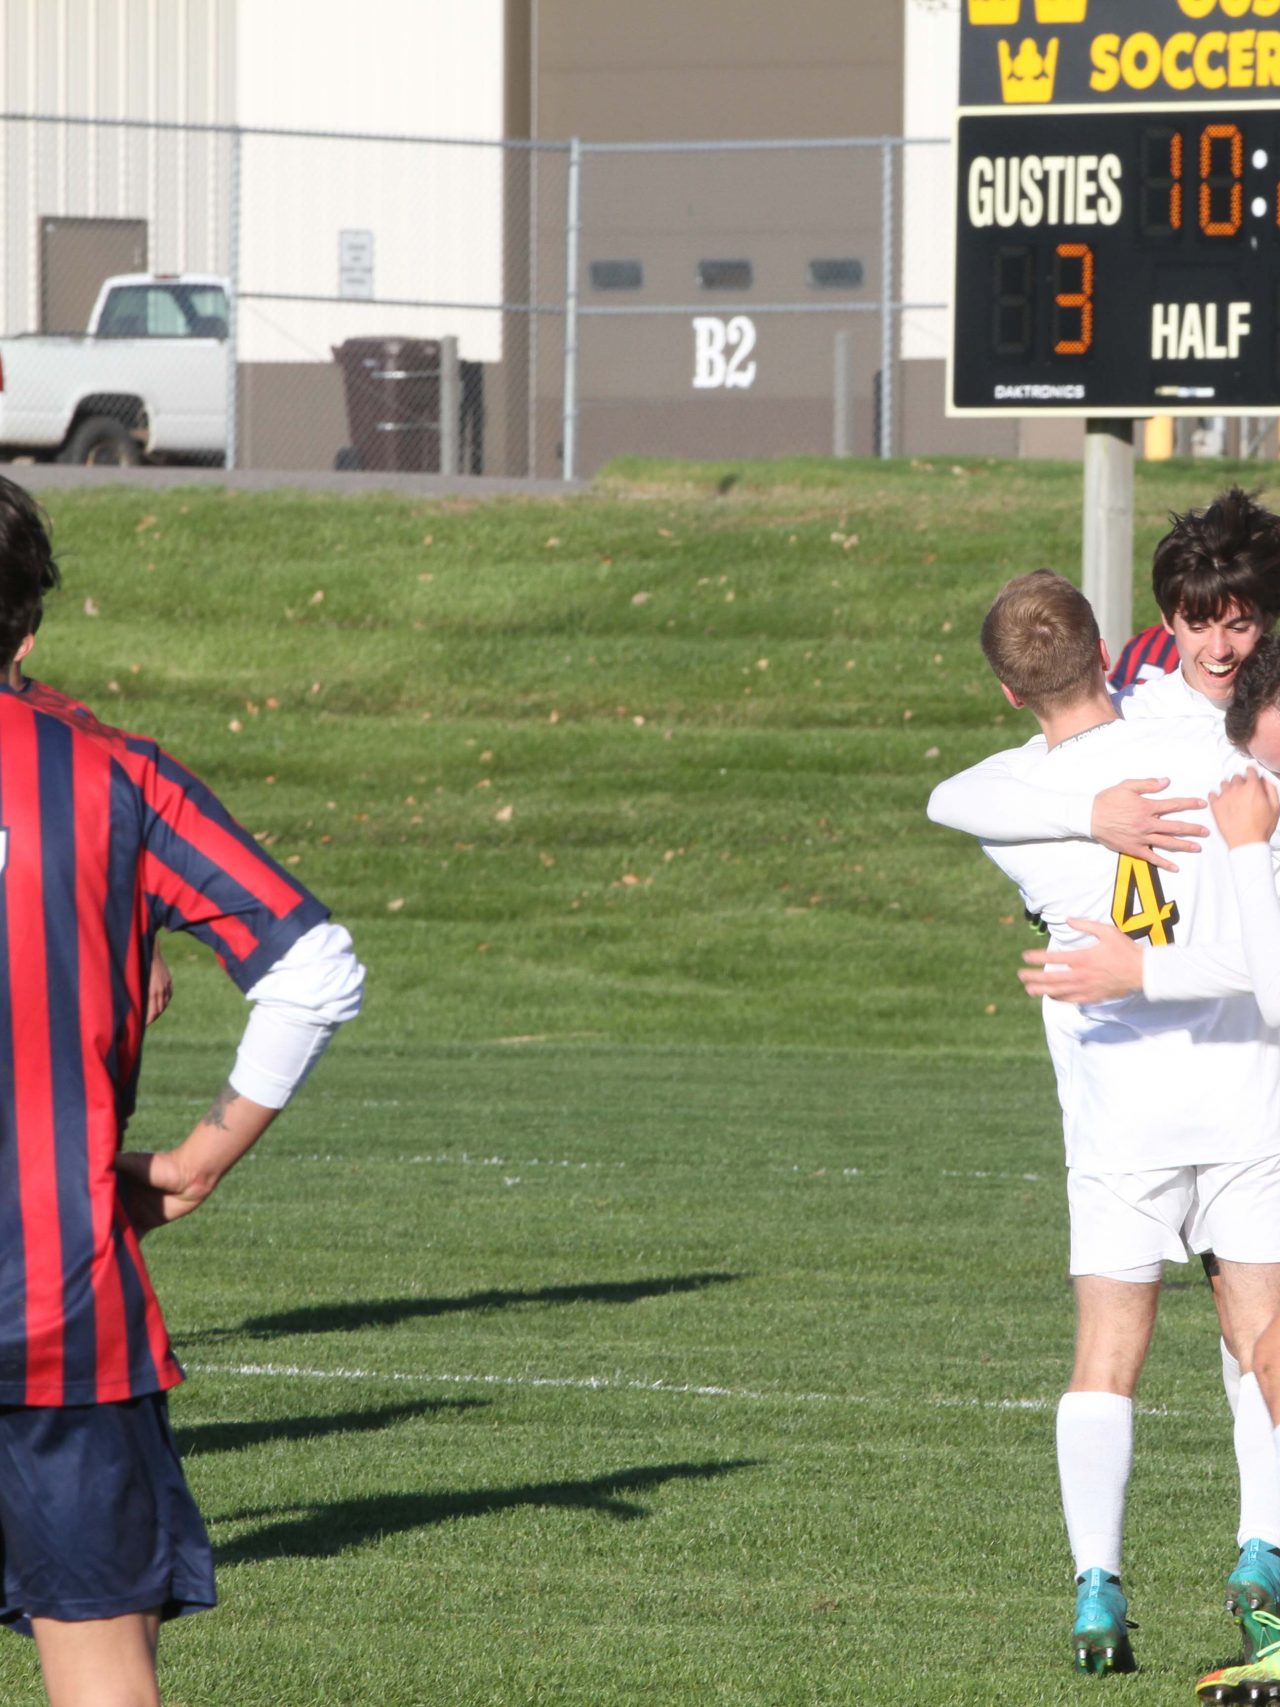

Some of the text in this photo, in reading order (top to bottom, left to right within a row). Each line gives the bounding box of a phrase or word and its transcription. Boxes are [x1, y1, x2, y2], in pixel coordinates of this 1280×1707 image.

[968, 153, 1122, 227] GUSTIES
[1054, 243, 1094, 354] 3
[1151, 302, 1251, 359] HALF
[692, 315, 757, 388] B2
[994, 384, 1085, 399] DAKTRONICS
[1111, 850, 1180, 947] 4
